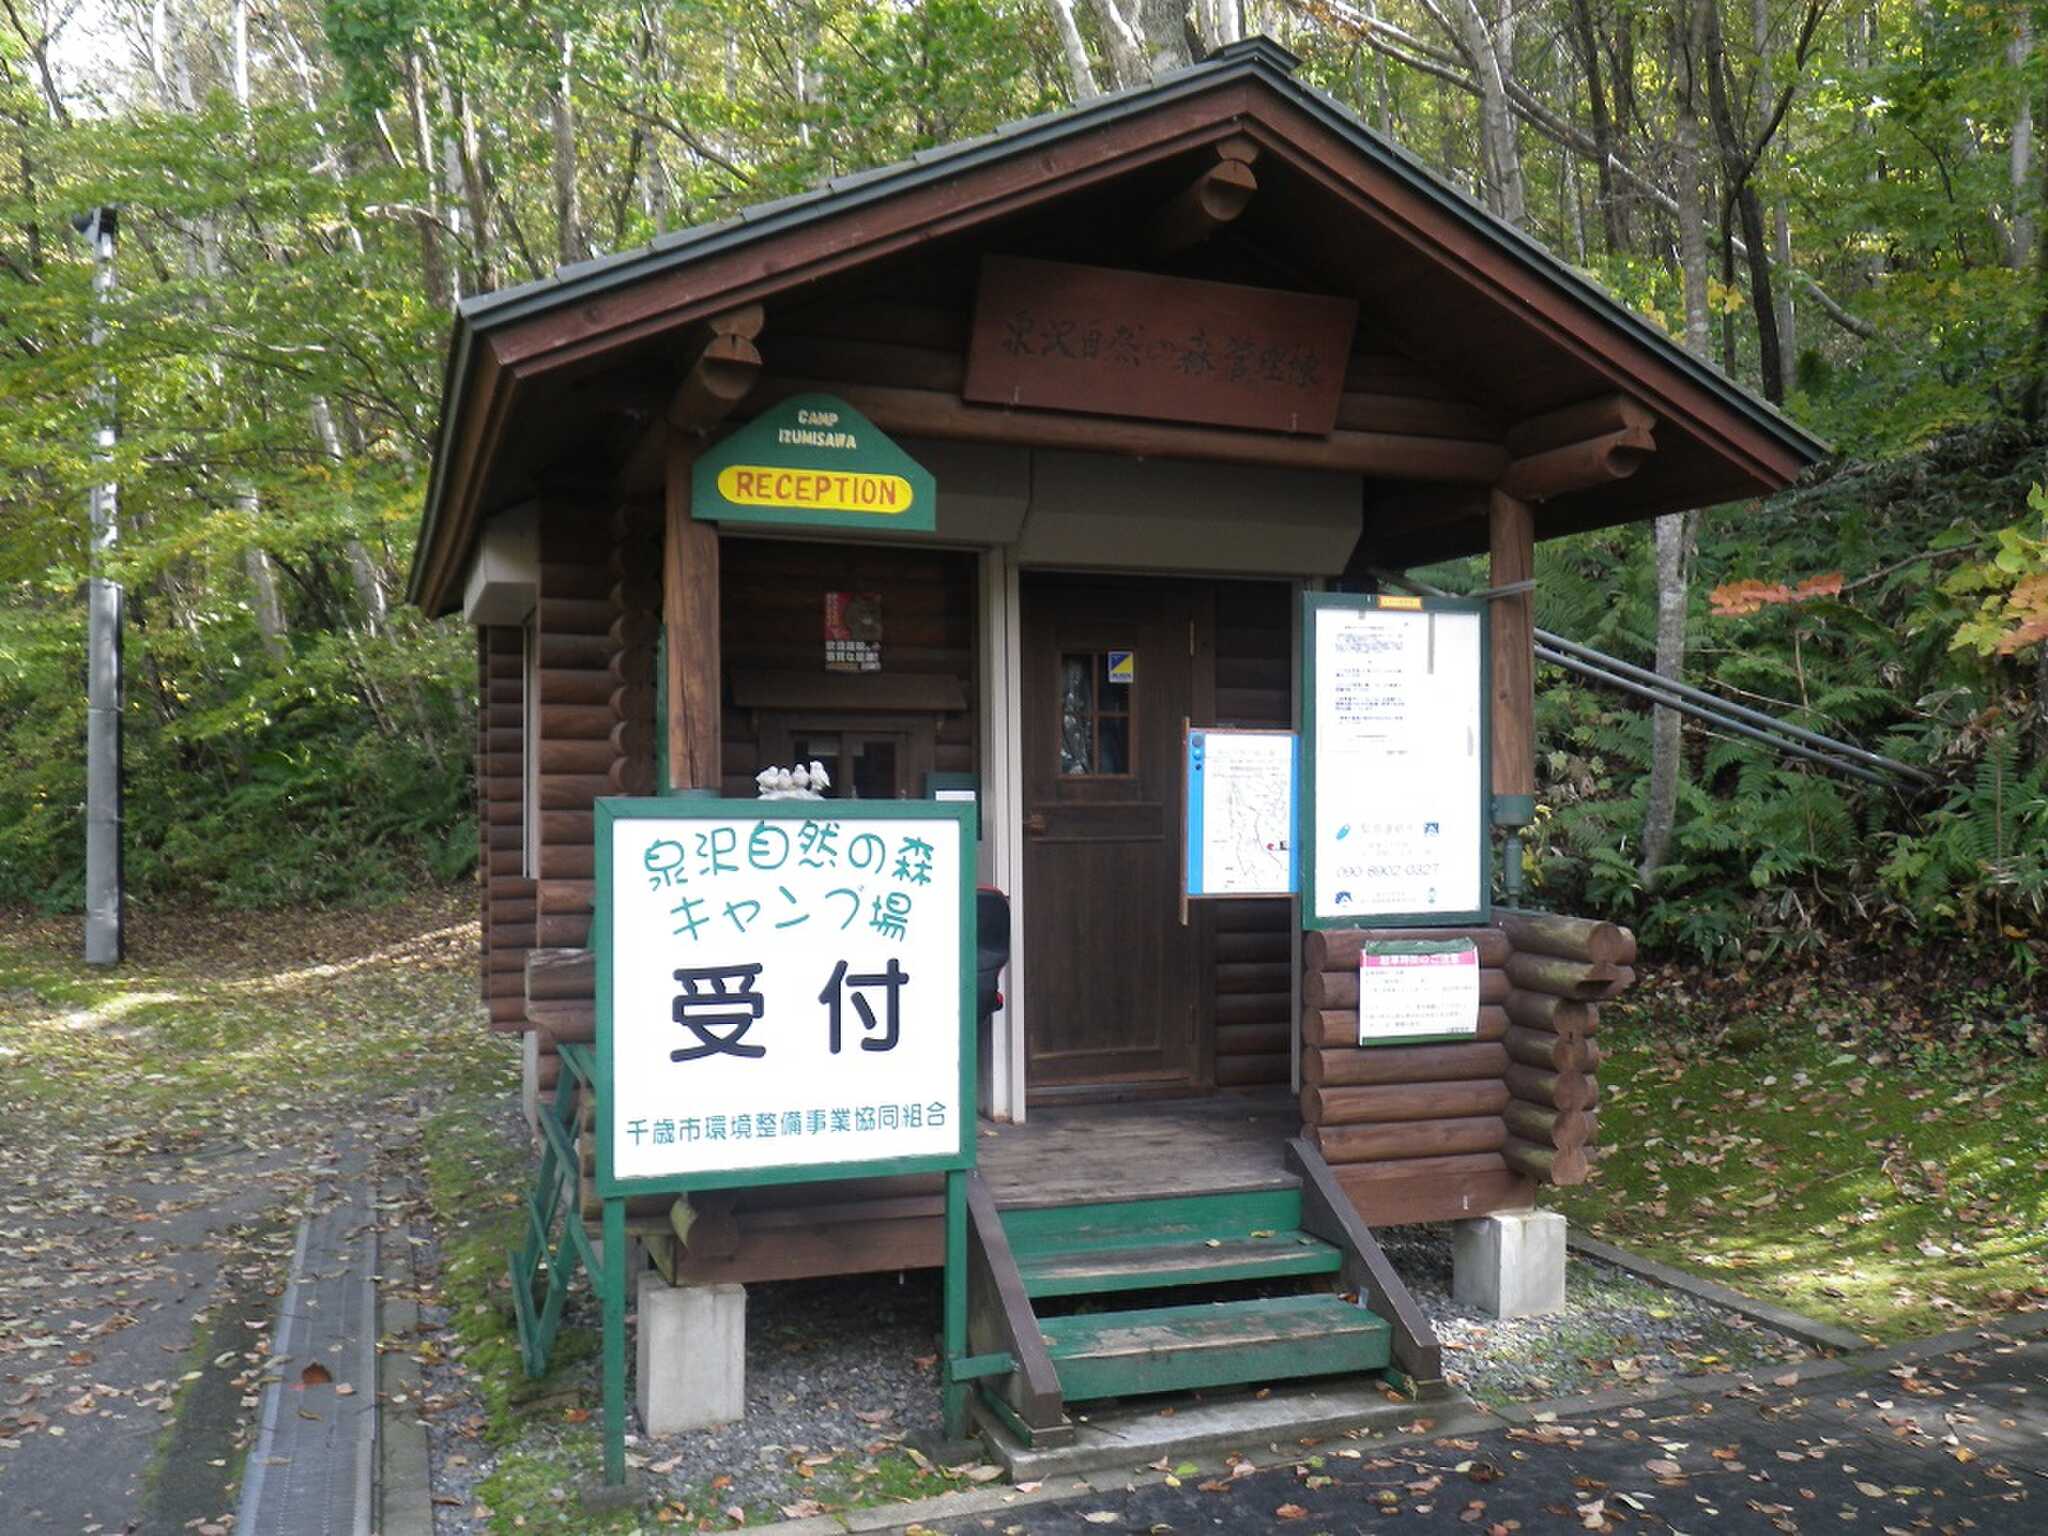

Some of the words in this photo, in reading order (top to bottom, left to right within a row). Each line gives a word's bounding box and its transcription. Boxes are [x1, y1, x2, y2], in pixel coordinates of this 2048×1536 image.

[778, 429, 857, 449] IZUMISAWA
[798, 409, 839, 427] CAMP
[736, 471, 897, 506] RECEPTION
[644, 820, 934, 892] 泉沢自然の森
[670, 885, 912, 942] キャンプ場
[670, 958, 910, 1063] 受付
[627, 1102, 946, 1146] 千歳市環境整備事業協同組合
